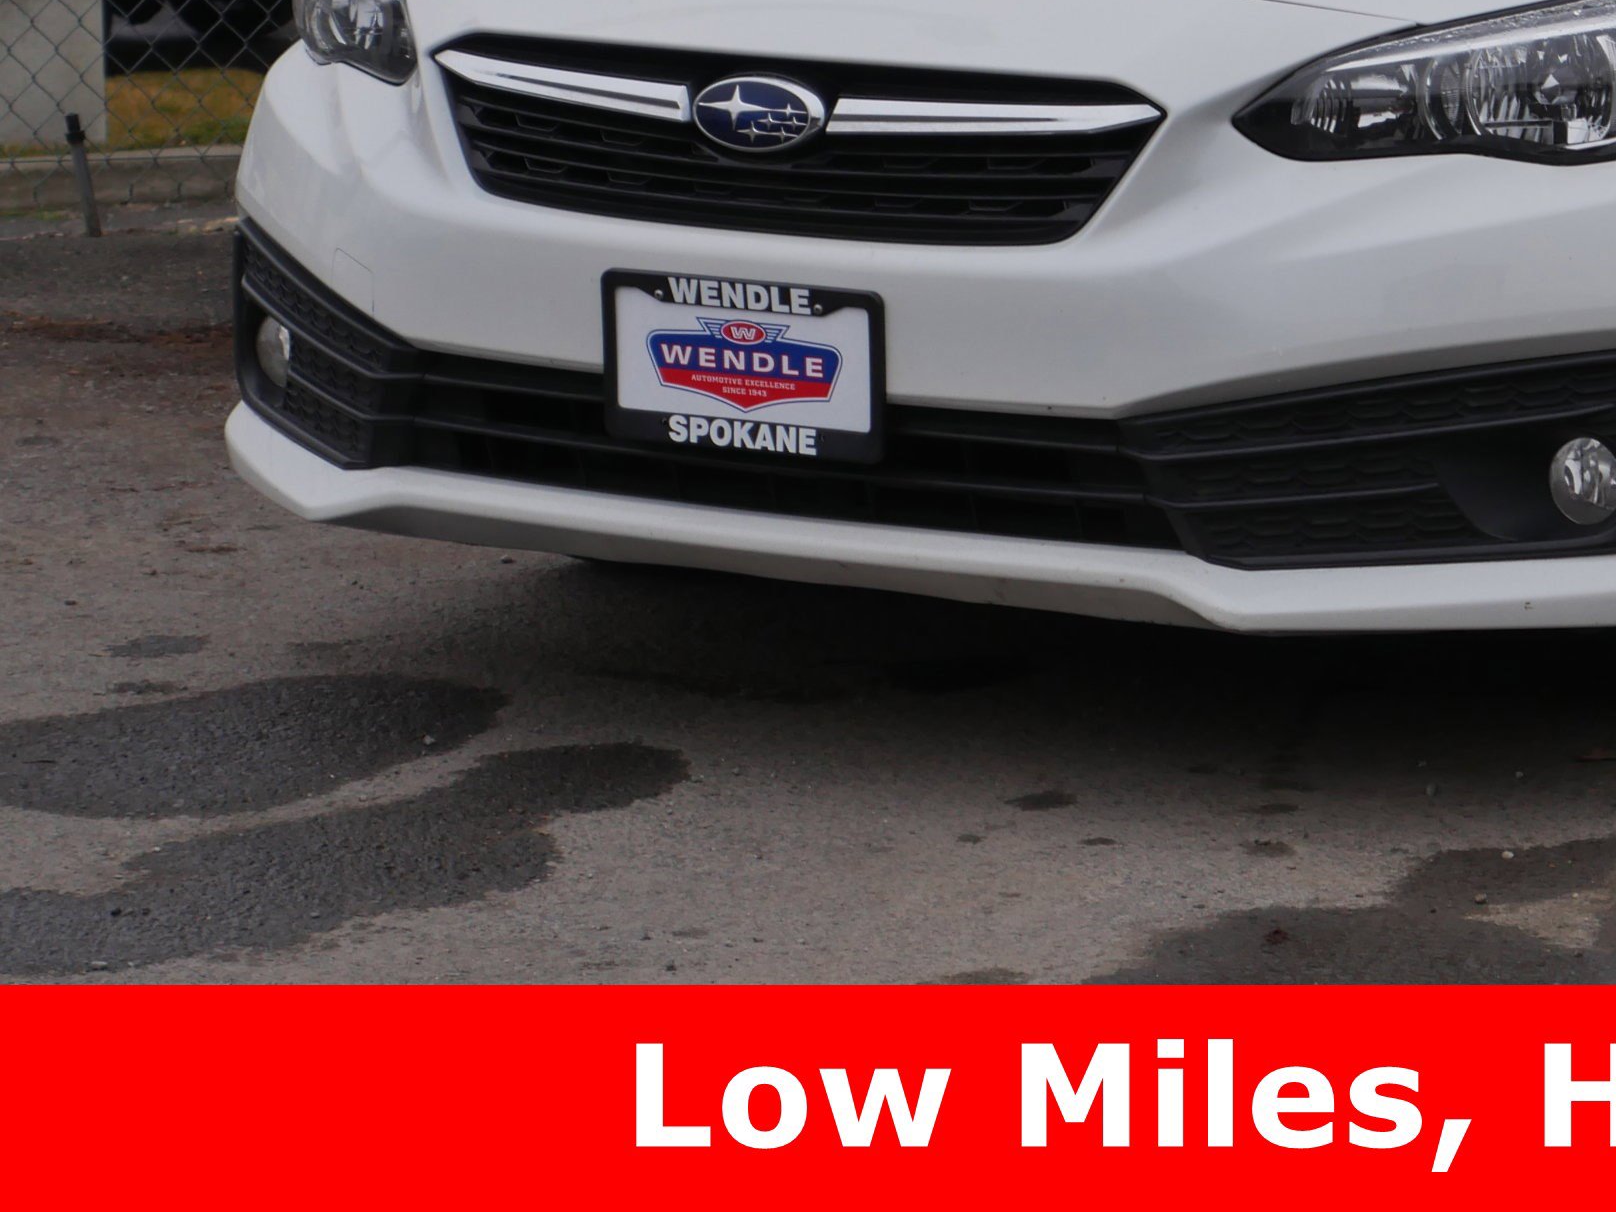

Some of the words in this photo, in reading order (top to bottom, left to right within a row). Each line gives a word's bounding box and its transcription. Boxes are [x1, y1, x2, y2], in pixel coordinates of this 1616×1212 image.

[667, 276, 812, 316] WENDLE
[660, 343, 824, 378] WENDLE
[691, 374, 743, 386] AUTOMOTIVE
[745, 379, 796, 391] EXCELLENCE
[722, 386, 746, 396] SINCE
[748, 388, 767, 397] 1943
[667, 414, 817, 457] SPOKANE
